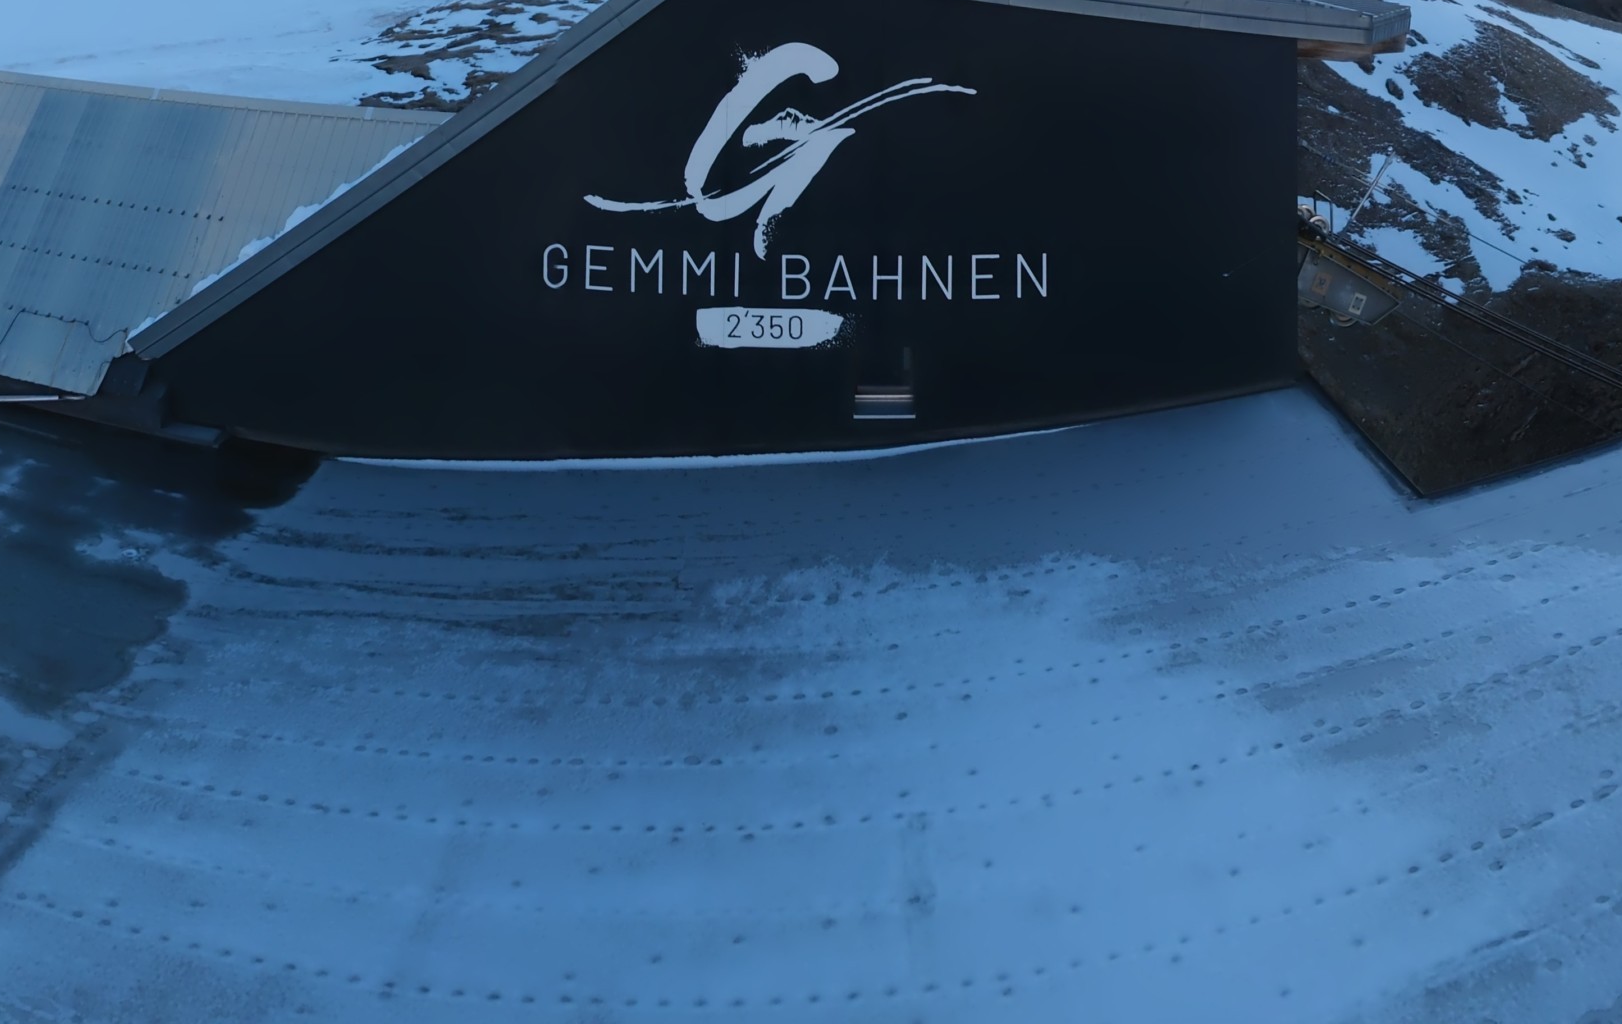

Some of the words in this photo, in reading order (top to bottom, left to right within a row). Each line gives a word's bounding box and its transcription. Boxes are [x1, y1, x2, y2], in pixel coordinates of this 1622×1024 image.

[542, 243, 740, 298] GEMMI
[781, 252, 1048, 301] BAHNEN
[726, 309, 804, 341] 2'350
